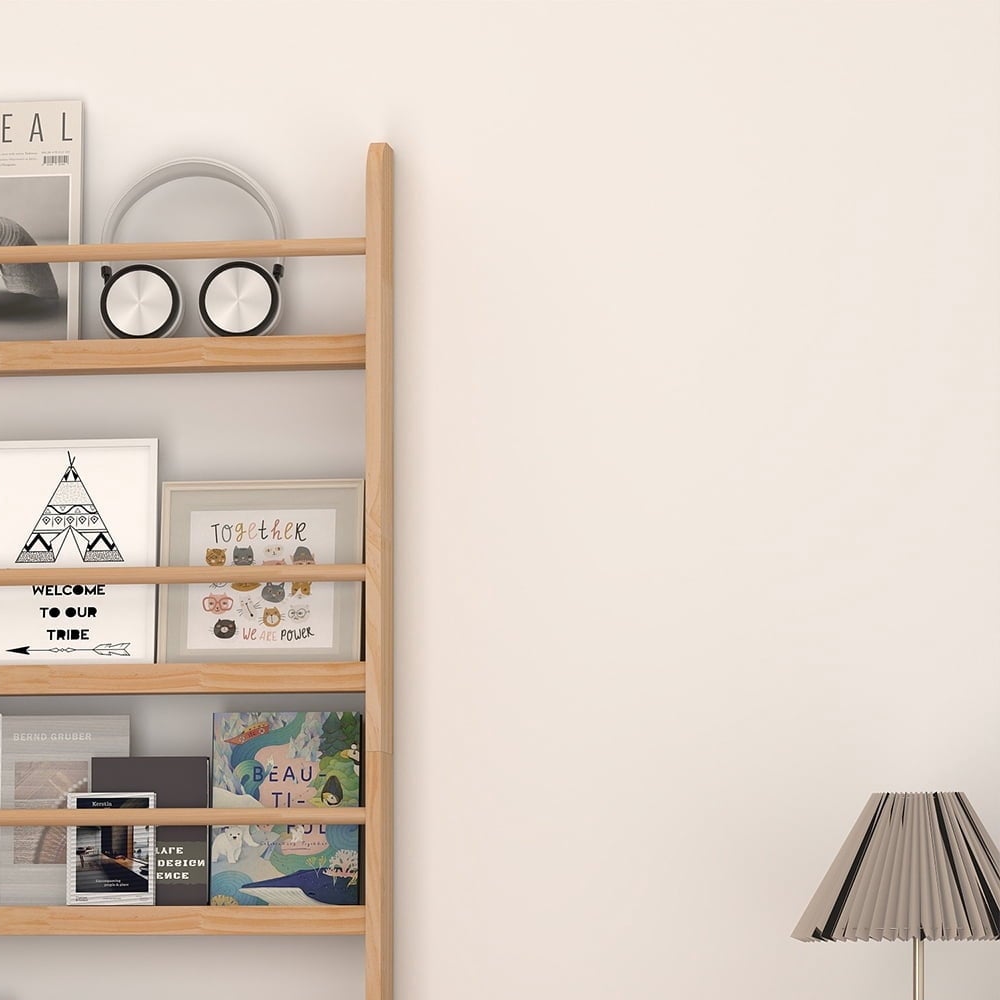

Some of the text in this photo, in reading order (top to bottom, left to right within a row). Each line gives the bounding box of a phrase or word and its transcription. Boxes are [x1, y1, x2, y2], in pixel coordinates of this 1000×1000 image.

[32, 584, 106, 596] WELCOME
[39, 606, 98, 618] TO OUR
[46, 629, 90, 640] TRIBE
[13, 732, 92, 741] BERND GRUBER
[253, 766, 326, 782] BEAU-
[271, 792, 305, 808] TI-
